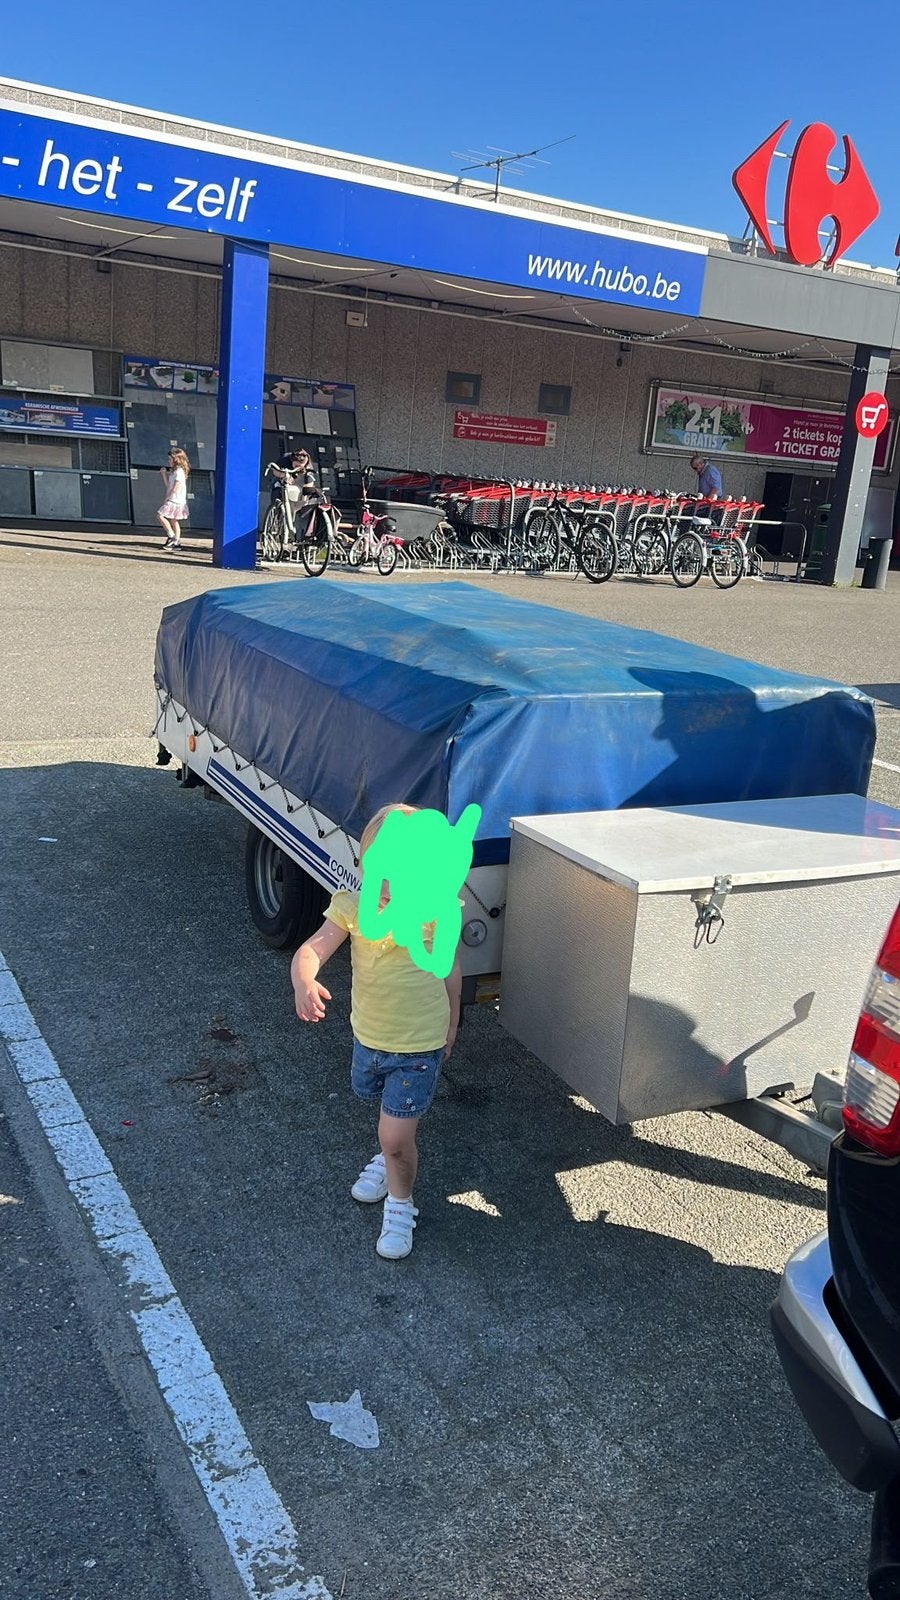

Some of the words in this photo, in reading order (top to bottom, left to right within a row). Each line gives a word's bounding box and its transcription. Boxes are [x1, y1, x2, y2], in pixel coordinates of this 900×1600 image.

[37, 139, 123, 200] het
[167, 176, 258, 223] zelf
[528, 253, 681, 301] www.hubo.be
[684, 431, 718, 449] GRATIS
[783, 426, 791, 438] 2
[793, 427, 825, 442] tickets
[775, 441, 780, 452] 1
[783, 441, 818, 456] TICKET
